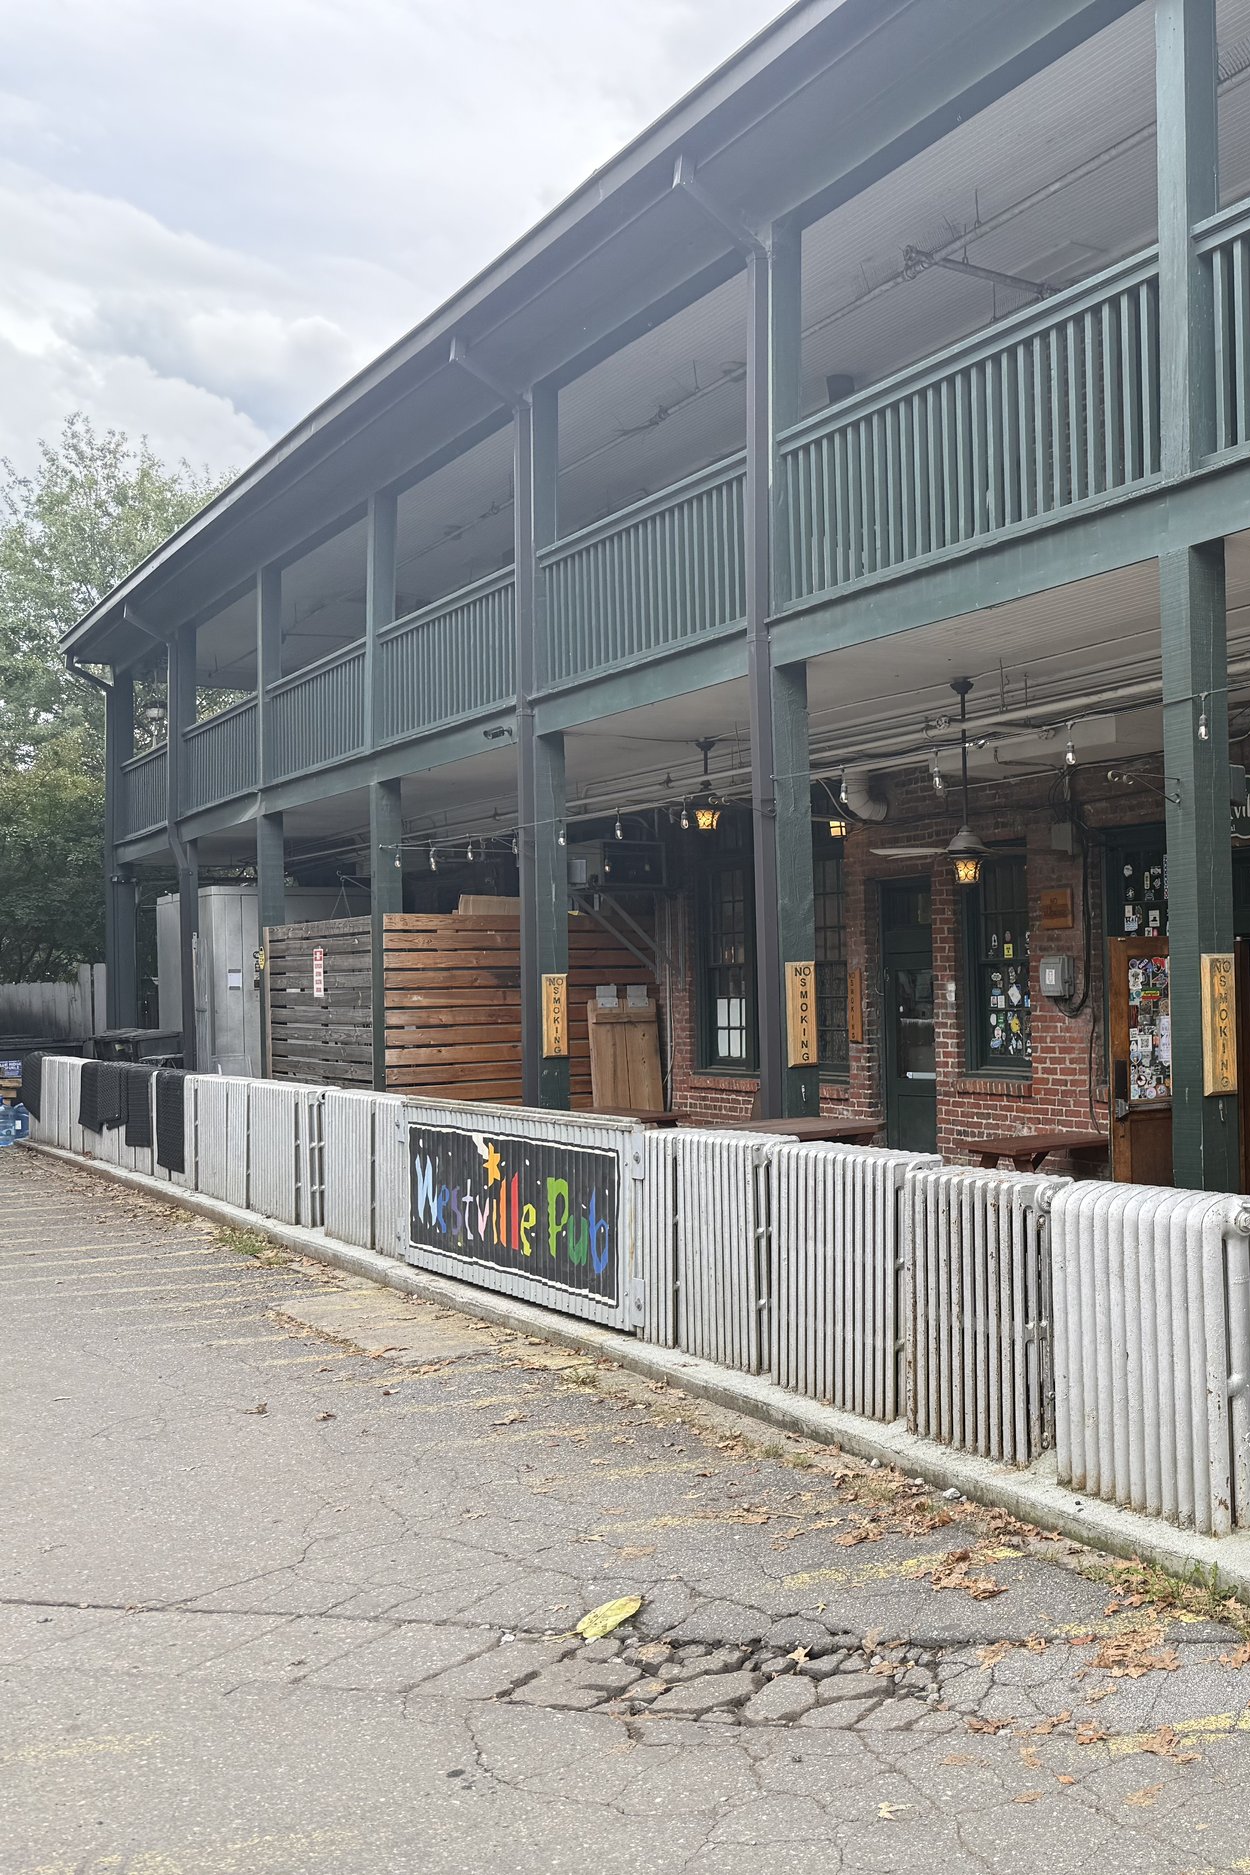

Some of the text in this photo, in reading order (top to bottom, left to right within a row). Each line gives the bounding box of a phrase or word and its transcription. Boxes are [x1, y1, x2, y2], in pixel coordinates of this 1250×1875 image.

[548, 978, 564, 986] NO
[794, 966, 811, 977] NO
[1215, 959, 1231, 974] NO
[553, 986, 561, 1054] SMOKING
[800, 978, 810, 1062] SMOKING
[1219, 975, 1230, 1088] SMOKING
[415, 1153, 610, 1275] Westville Pub
